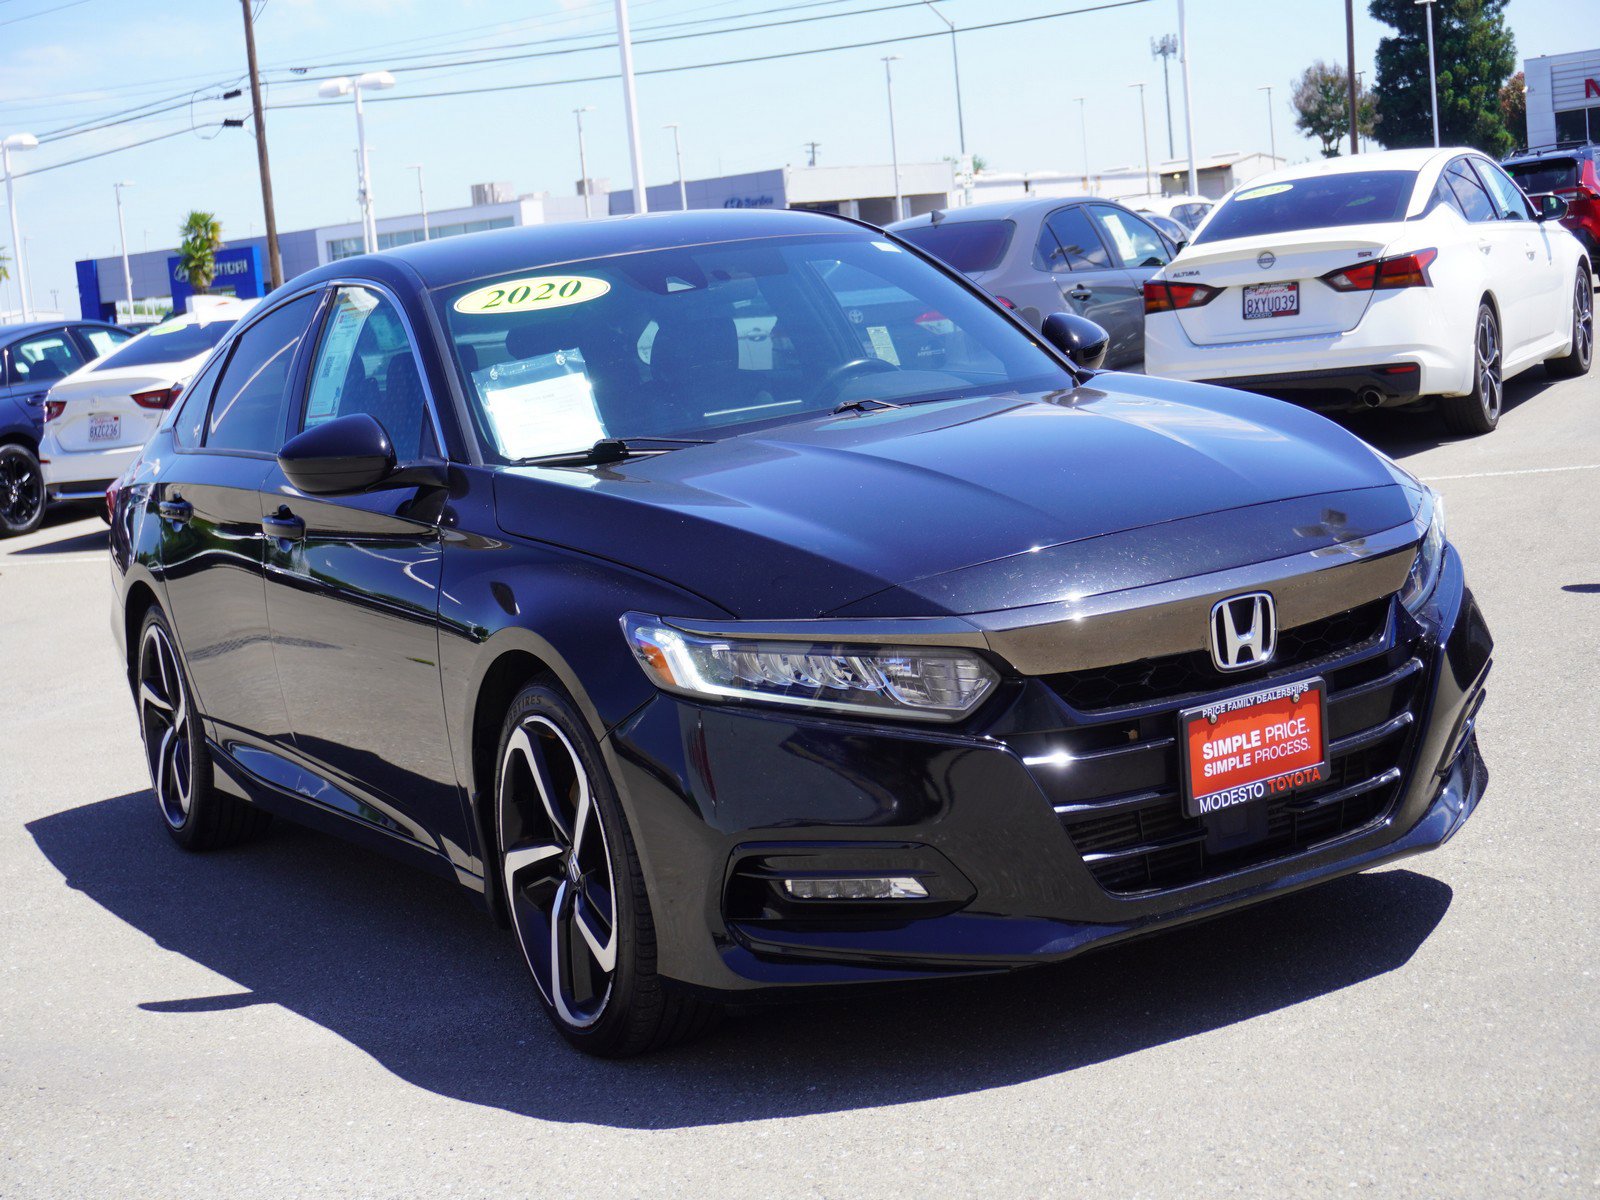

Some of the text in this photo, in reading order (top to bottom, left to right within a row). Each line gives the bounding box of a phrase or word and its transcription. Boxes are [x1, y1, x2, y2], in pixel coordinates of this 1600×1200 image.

[1173, 270, 1200, 278] ALTIMA
[481, 280, 582, 309] 2020
[1247, 294, 1295, 314] 8XYU039
[1202, 683, 1309, 718] PRICE FAMILY DEALERSHIPS
[1202, 718, 1310, 760] SIMPLE PRICE.
[1203, 737, 1311, 777] SIMPLE PROCESS.
[1199, 767, 1322, 813] MODESTO TOYOTA
